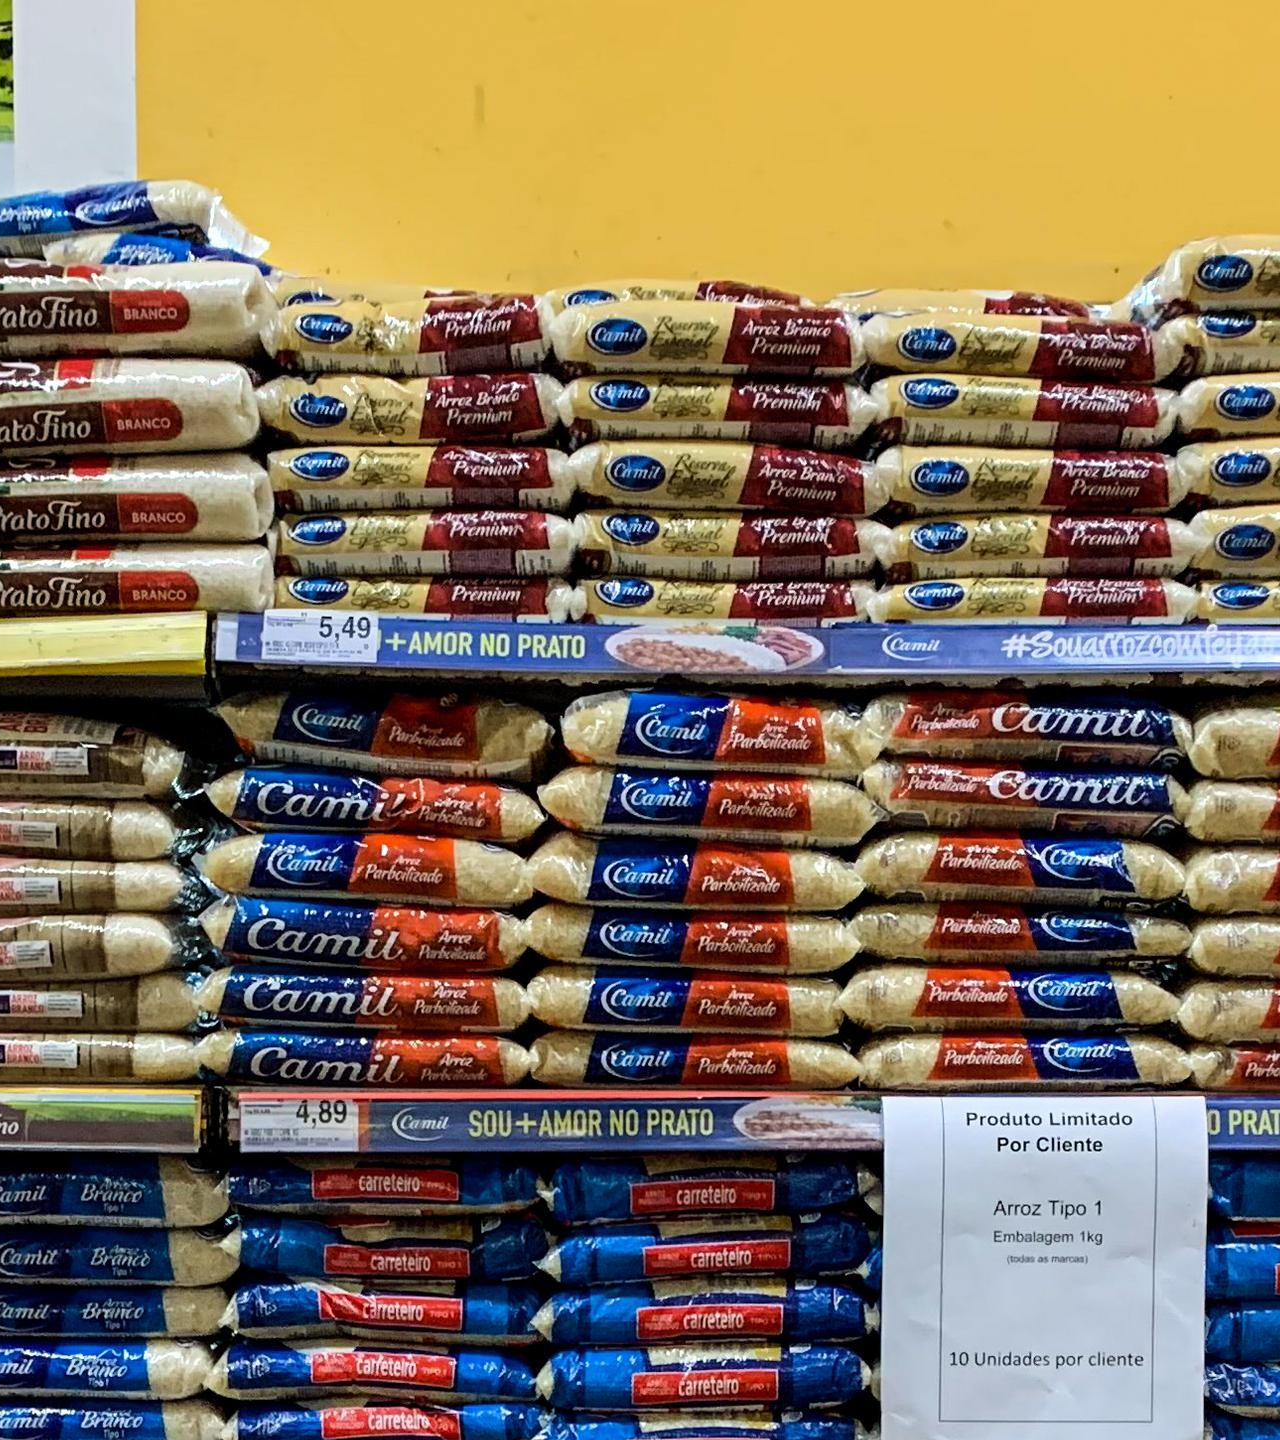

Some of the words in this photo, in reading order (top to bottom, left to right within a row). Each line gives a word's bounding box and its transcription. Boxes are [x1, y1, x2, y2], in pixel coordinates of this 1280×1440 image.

[597, 326, 641, 347] Camil
[742, 320, 778, 336] Arroz
[752, 338, 820, 356] Premium
[917, 468, 964, 487] Camil
[1070, 479, 1139, 499] Premium
[1221, 531, 1270, 551] Camil
[318, 616, 371, 644] 5,49
[479, 633, 510, 656] NO
[517, 632, 585, 659] PRATO
[991, 703, 1152, 738] Camil
[364, 863, 443, 885] Parboilizado
[247, 917, 403, 962] Camil
[244, 977, 399, 1017] Camil
[929, 986, 1008, 1005] Parboilizado
[698, 1000, 776, 1019] Parboilizado
[251, 1047, 403, 1085] Camil
[296, 1101, 348, 1129] 4,89
[609, 1108, 639, 1136] NO
[646, 1107, 714, 1137] PRATO
[966, 1112, 1043, 1127] Produto
[1049, 1112, 1133, 1127] Limitado
[996, 1137, 1031, 1153] Por
[1036, 1136, 1104, 1153] Cliente
[81, 1184, 143, 1203] Branco
[676, 1184, 737, 1205] carreteiro
[993, 1200, 1042, 1217] Arroz
[1049, 1200, 1087, 1219] Tipo
[1095, 1200, 1102, 1216] 1
[993, 1230, 1074, 1245] Embalagem
[1080, 1231, 1103, 1245] 1kg
[370, 1253, 431, 1273] carreteiro
[1007, 1255, 1035, 1265] (todas
[683, 1308, 744, 1330] carreteiro
[66, 1358, 128, 1378] Branco
[949, 1352, 969, 1367] 10
[974, 1351, 1050, 1367] Unidades
[1055, 1355, 1084, 1370] por
[1088, 1352, 1144, 1367] cliente
